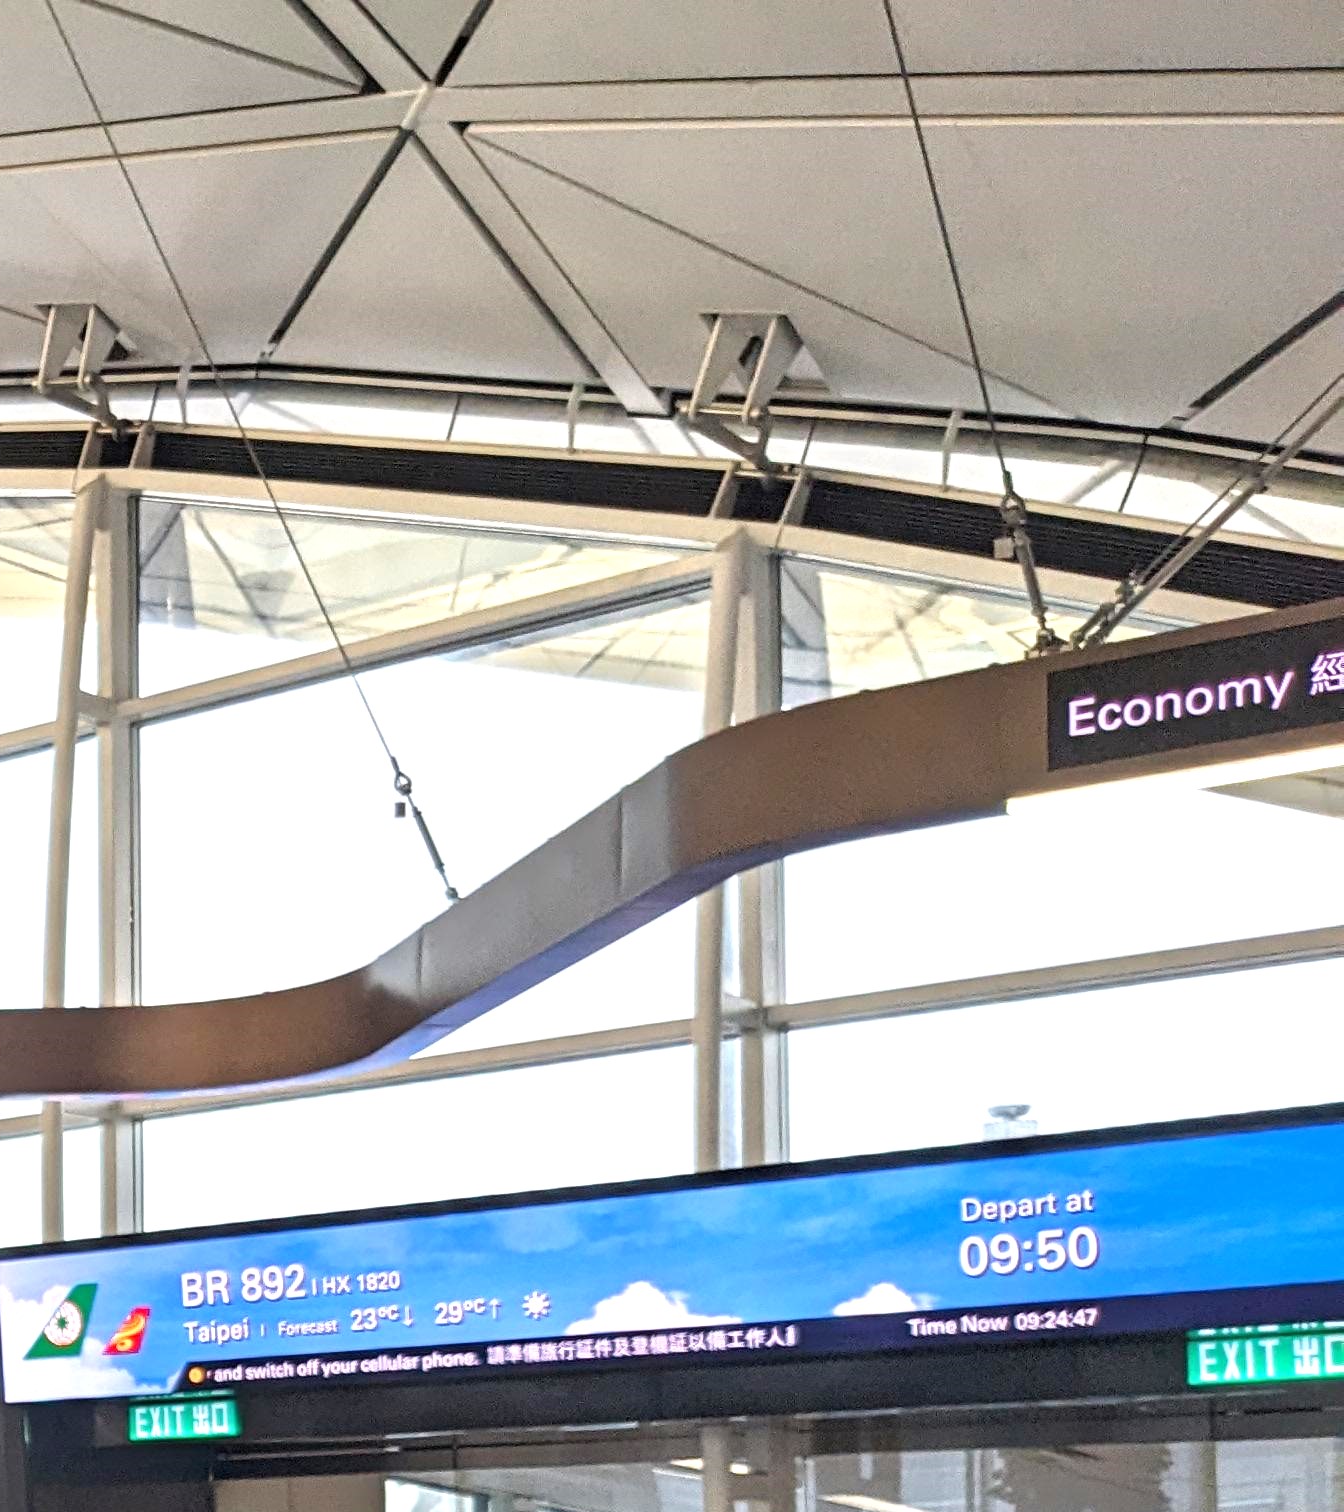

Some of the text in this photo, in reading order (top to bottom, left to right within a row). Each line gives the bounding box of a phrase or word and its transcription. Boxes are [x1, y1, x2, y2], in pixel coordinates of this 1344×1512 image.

[1067, 670, 1295, 738] Economy
[961, 1189, 1094, 1223] Depart at
[959, 1225, 1099, 1278] 09:50
[180, 1263, 401, 1308] BR 892 HX 1820
[183, 1316, 250, 1346] Taipei
[277, 1318, 339, 1338] Forecast
[907, 1307, 1099, 1337] Time Now 09:24:47
[213, 1362, 243, 1383] and
[244, 1358, 295, 1380] switch
[296, 1356, 321, 1378] off
[321, 1358, 358, 1379] your
[360, 1352, 419, 1374] cellular
[421, 1350, 480, 1373] phone.
[1197, 1333, 1344, 1382] EXIT 出口
[135, 1401, 229, 1439] EXIT 出口
